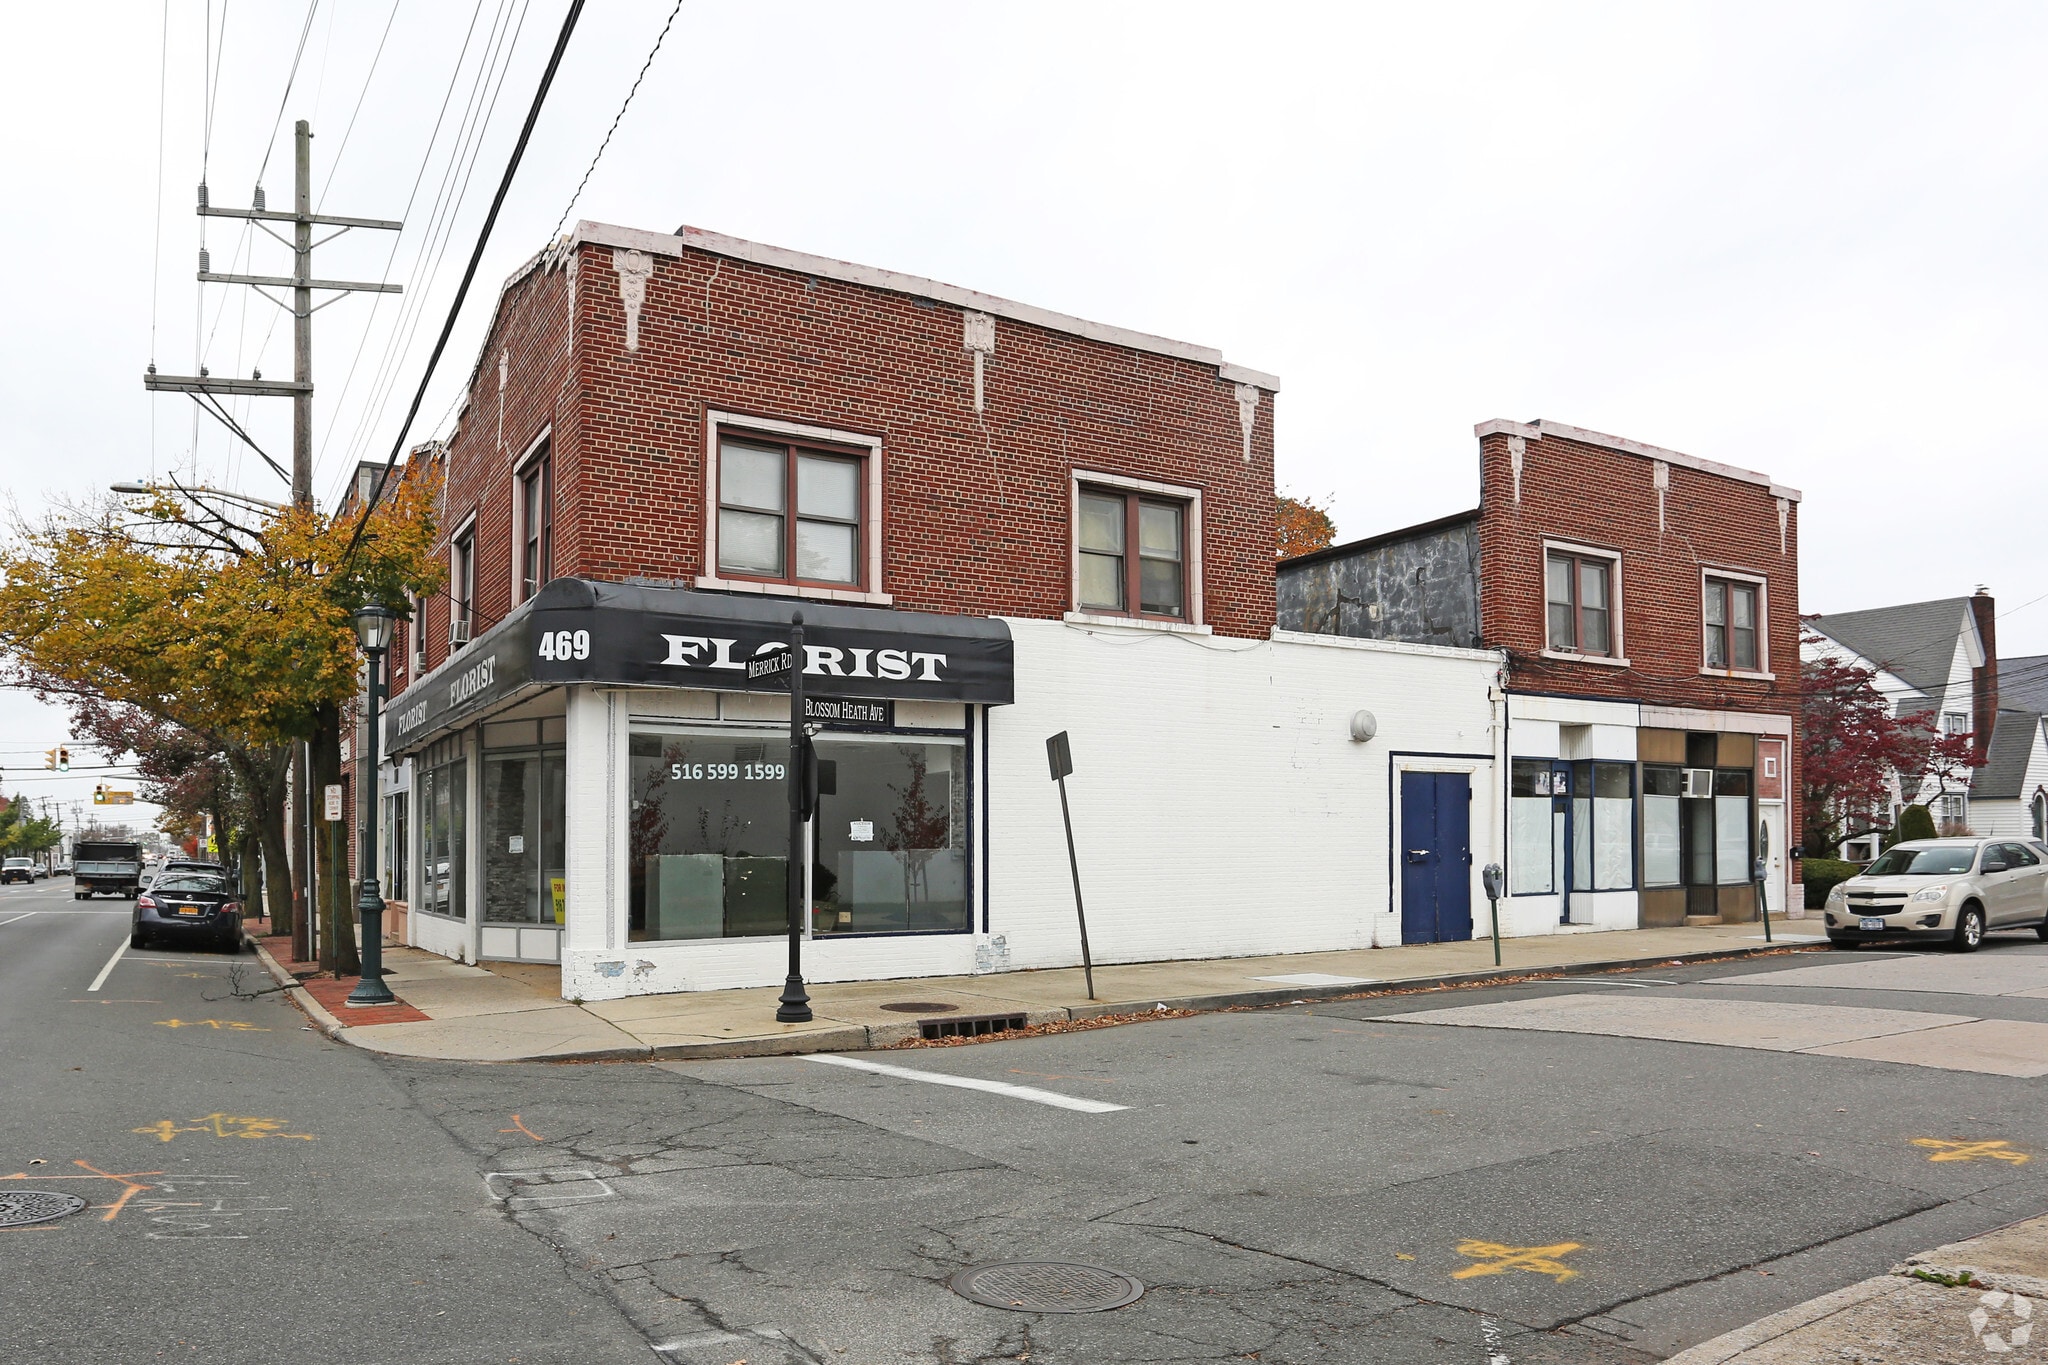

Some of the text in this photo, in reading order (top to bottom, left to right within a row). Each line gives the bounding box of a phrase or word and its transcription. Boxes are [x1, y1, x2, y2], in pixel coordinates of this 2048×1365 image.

[538, 630, 590, 661] 469
[748, 652, 793, 679] MERRICK RD
[449, 655, 496, 708] FLORIST
[398, 700, 428, 737] FLORIST
[805, 698, 885, 722] BLOSSOM HEATH AVE
[671, 763, 785, 781] 516 599 1599
